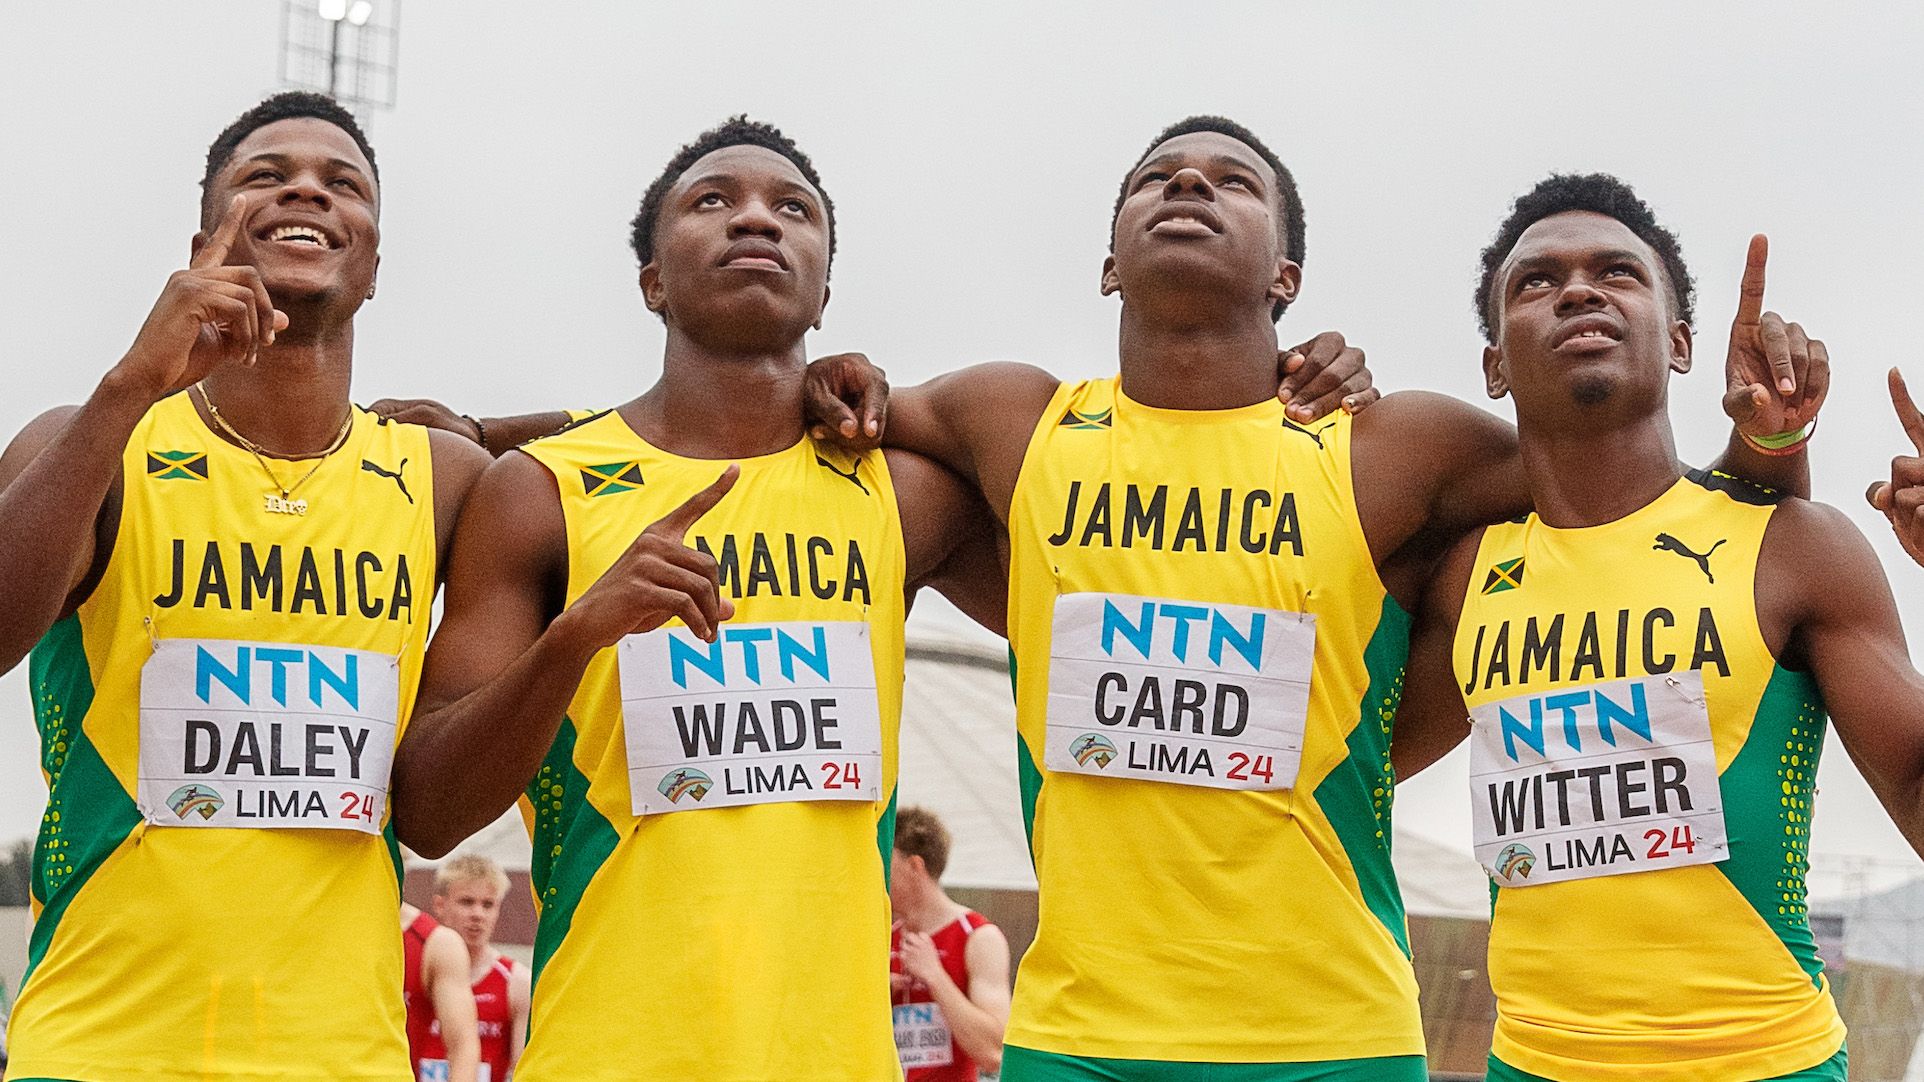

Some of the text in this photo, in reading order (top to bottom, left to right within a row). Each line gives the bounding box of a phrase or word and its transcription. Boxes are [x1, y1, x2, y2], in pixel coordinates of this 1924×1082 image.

[1047, 481, 1304, 557] JAMAICA
[153, 539, 412, 625] JAMAICA
[695, 532, 871, 606] MAICA
[668, 626, 830, 689] NTN
[1101, 597, 1266, 672] NTN
[1465, 607, 1731, 696] JAMAICA
[196, 645, 359, 711] NTN
[1094, 672, 1249, 738] CARD
[183, 720, 370, 779] DALEY
[672, 698, 842, 759] WADE
[1499, 682, 1653, 763] NTN
[724, 762, 861, 795] LIMA 24
[1128, 741, 1273, 783] LIMA 24
[236, 789, 374, 824] LIMA 24
[1488, 757, 1694, 837] WITTER
[1545, 825, 1695, 872] LIMA 24
